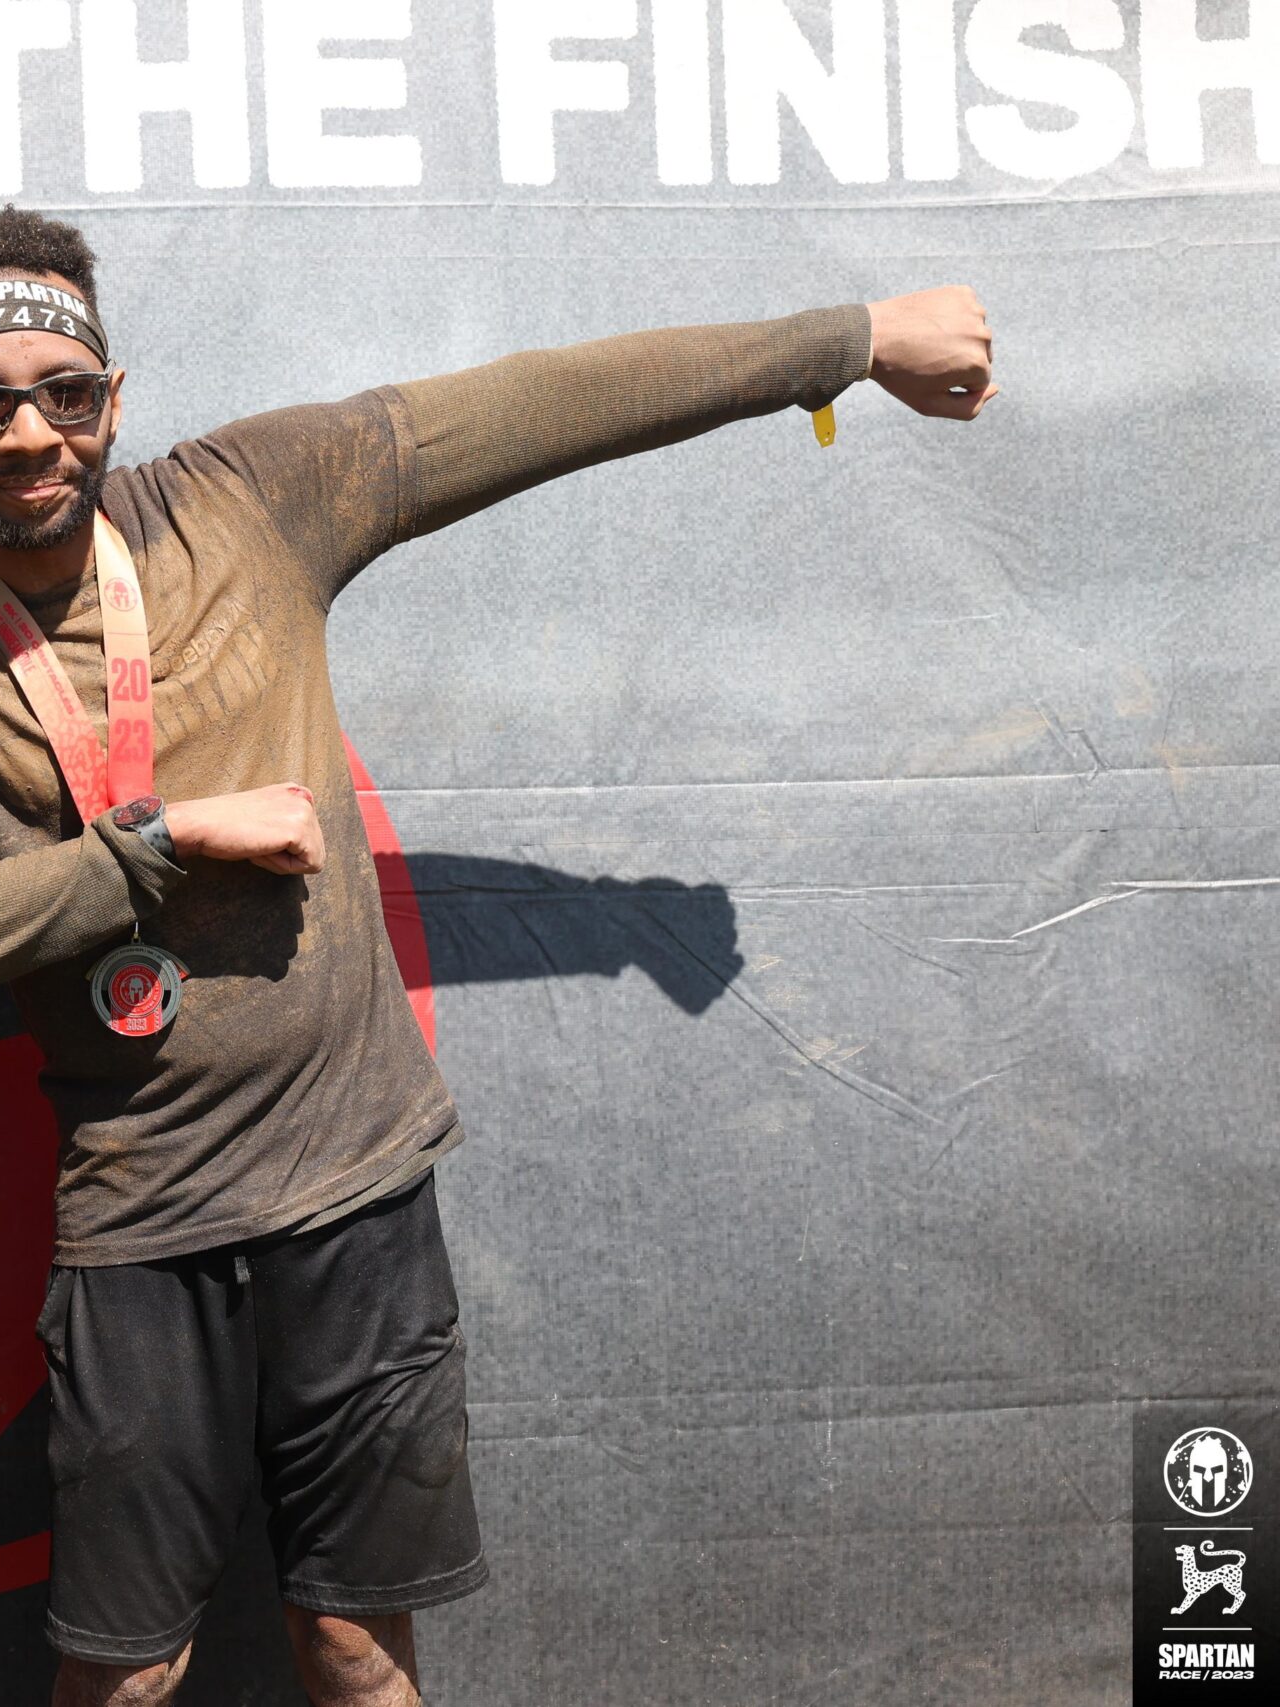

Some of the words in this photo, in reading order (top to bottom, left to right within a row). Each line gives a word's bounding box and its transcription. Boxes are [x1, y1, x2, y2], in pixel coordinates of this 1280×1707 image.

[493, 0, 1280, 186] FINISH
[111, 657, 149, 702] 20
[113, 718, 149, 763] 23
